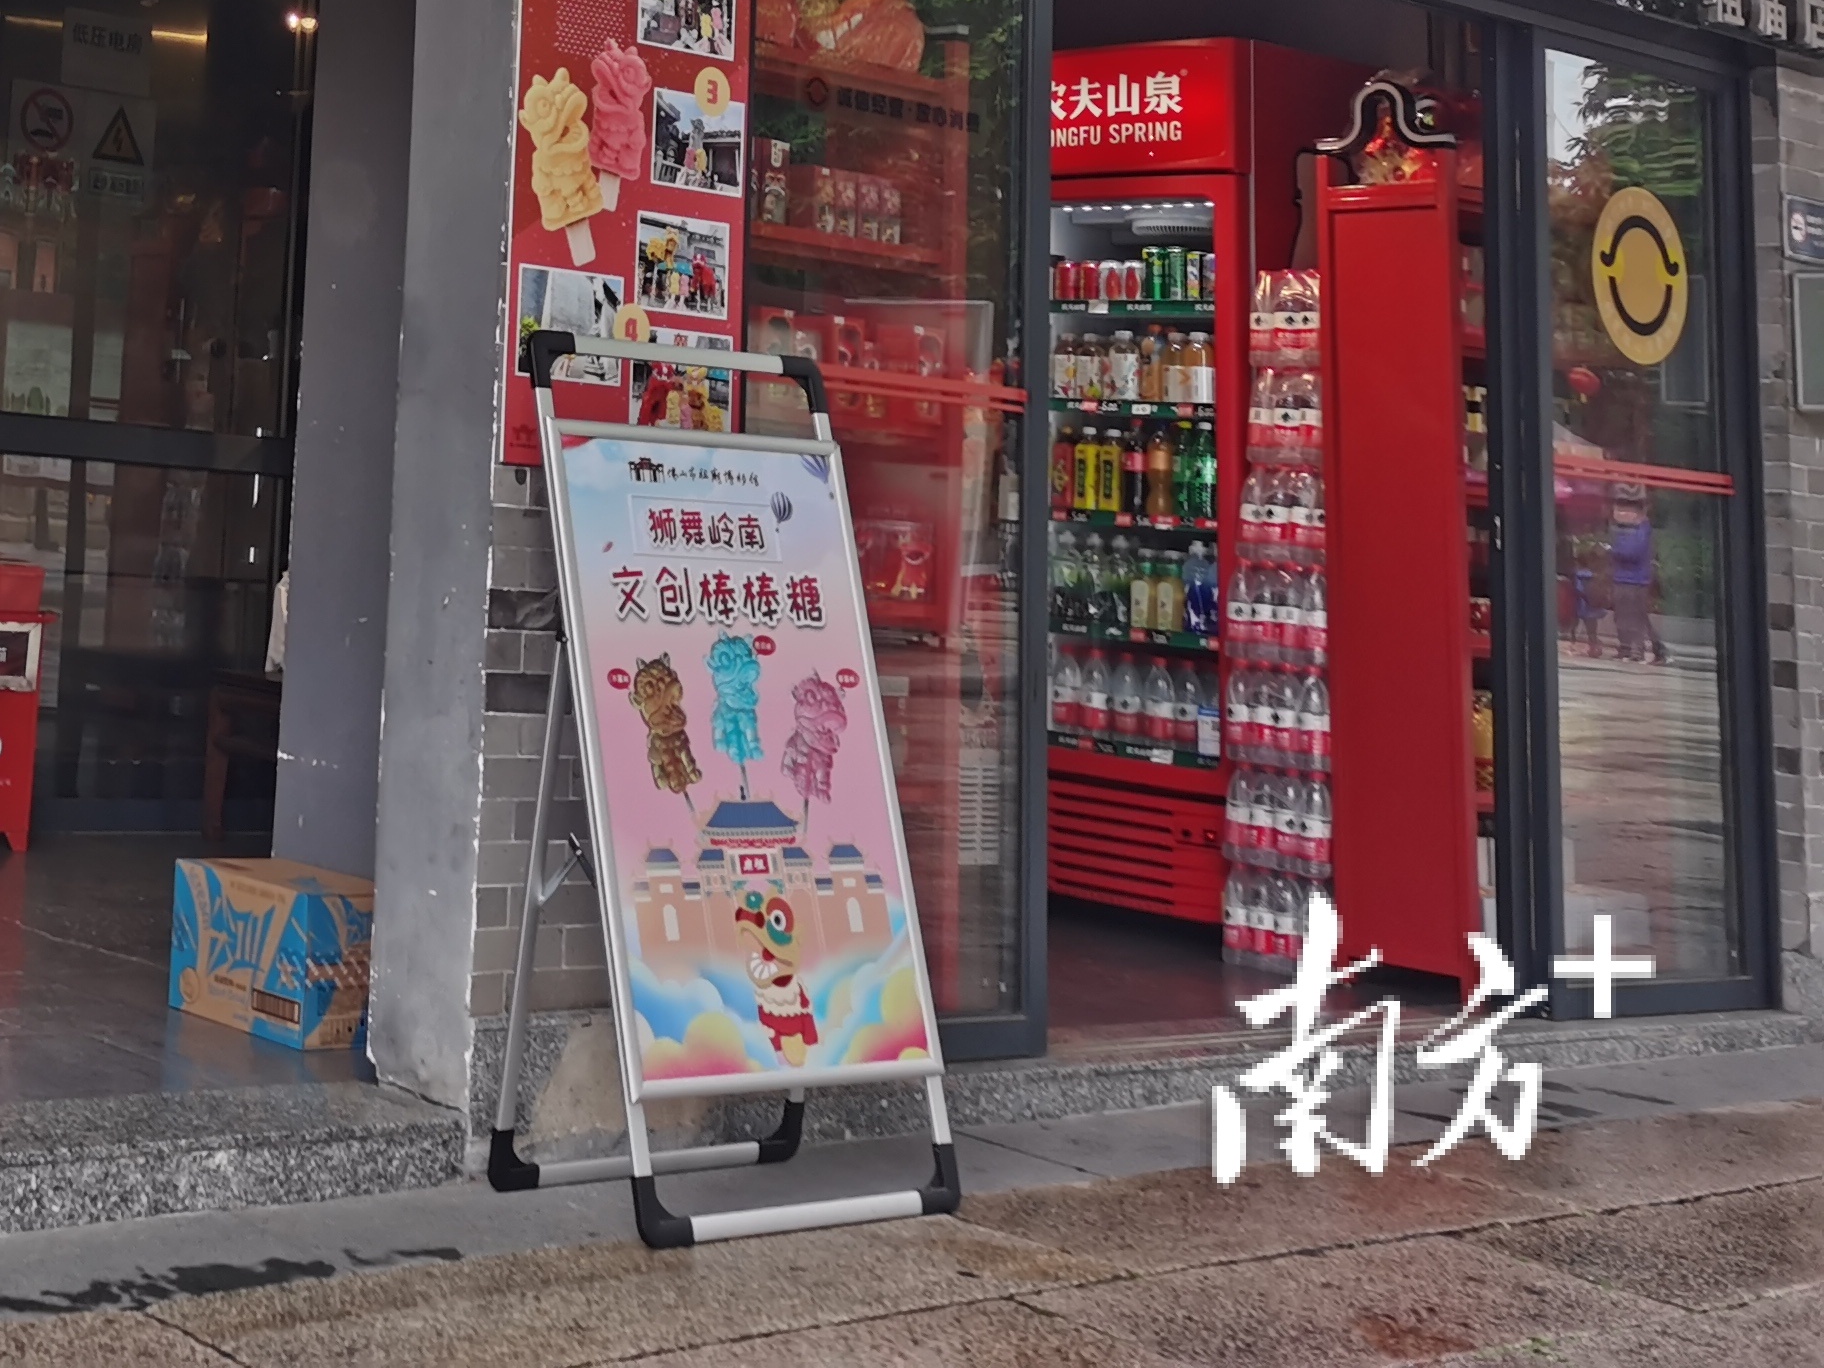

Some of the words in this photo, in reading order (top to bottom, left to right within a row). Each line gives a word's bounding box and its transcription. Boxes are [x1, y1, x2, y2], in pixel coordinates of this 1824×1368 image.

[1108, 120, 1183, 145] SPRING
[648, 507, 766, 551] 狮舞岭南
[612, 564, 824, 624] 文创棒棒糖
